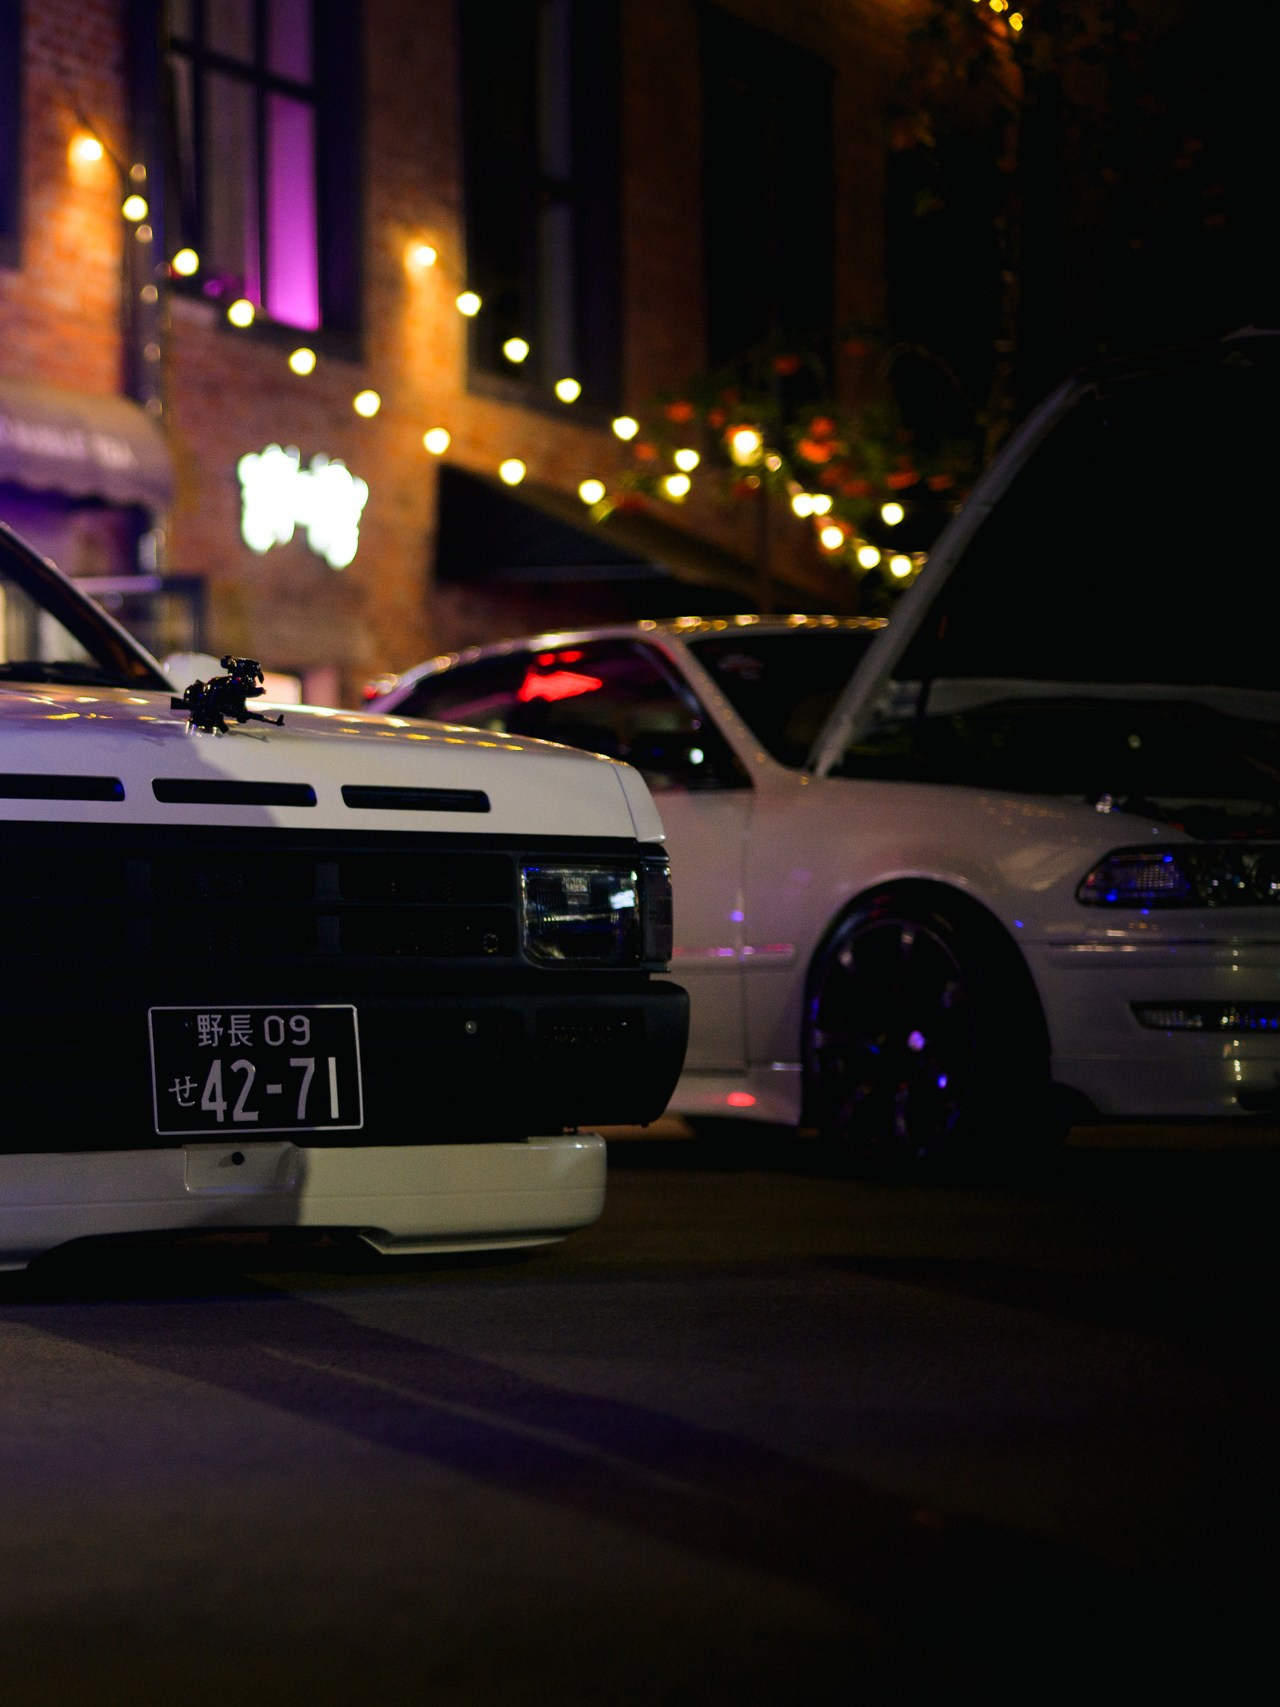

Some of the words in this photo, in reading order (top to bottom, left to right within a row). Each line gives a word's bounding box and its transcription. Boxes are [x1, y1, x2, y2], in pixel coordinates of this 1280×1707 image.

[196, 1013, 254, 1048] 野長
[263, 1014, 311, 1047] 09
[168, 1075, 198, 1107] せ
[201, 1056, 340, 1123] 42-71
